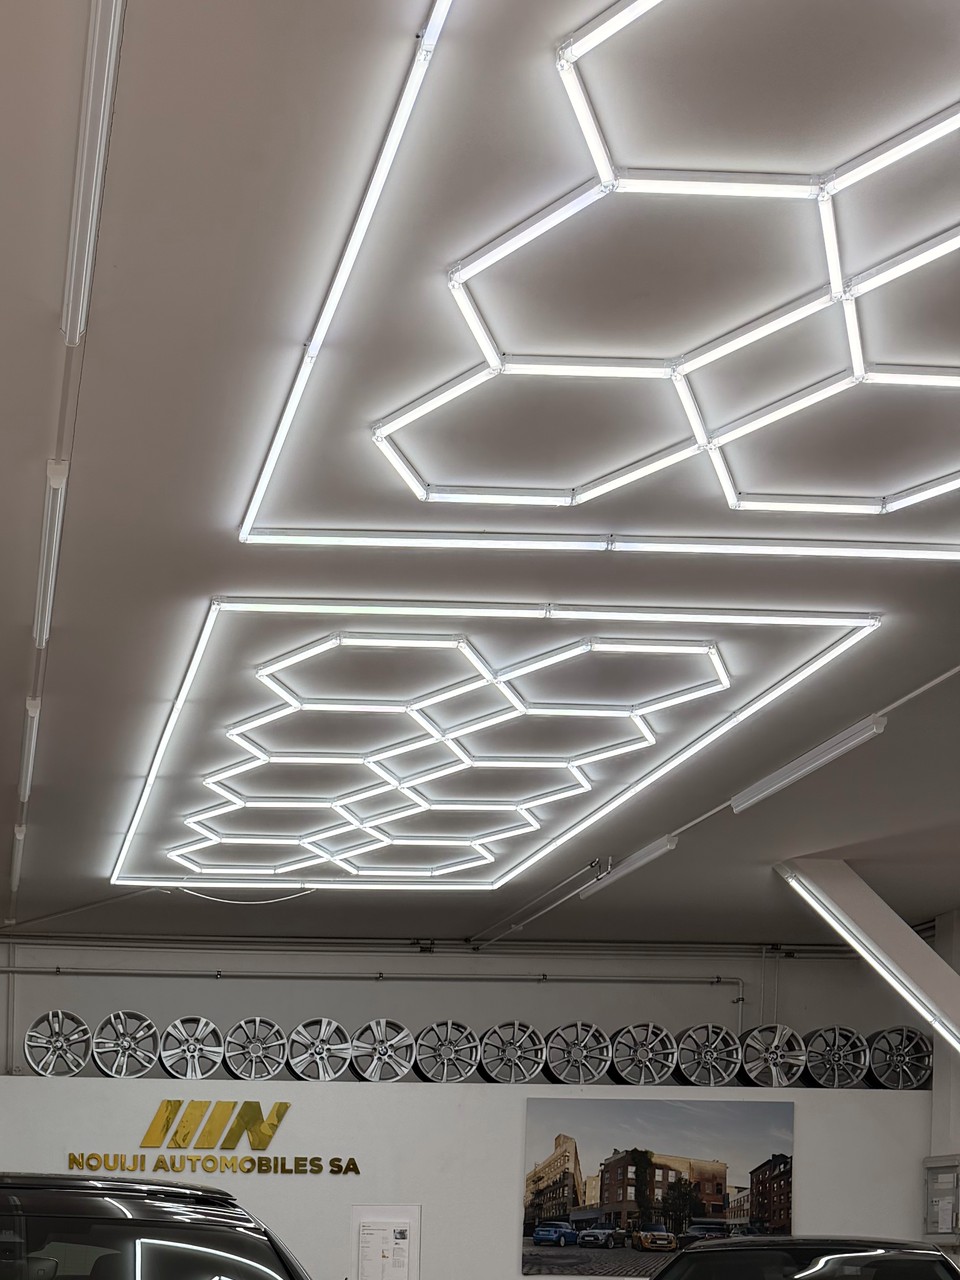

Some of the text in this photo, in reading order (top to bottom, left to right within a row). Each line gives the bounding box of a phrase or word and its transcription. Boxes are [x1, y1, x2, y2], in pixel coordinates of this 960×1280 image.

[68, 1152, 361, 1175] NOUIJI AUTOMOBILES SA
